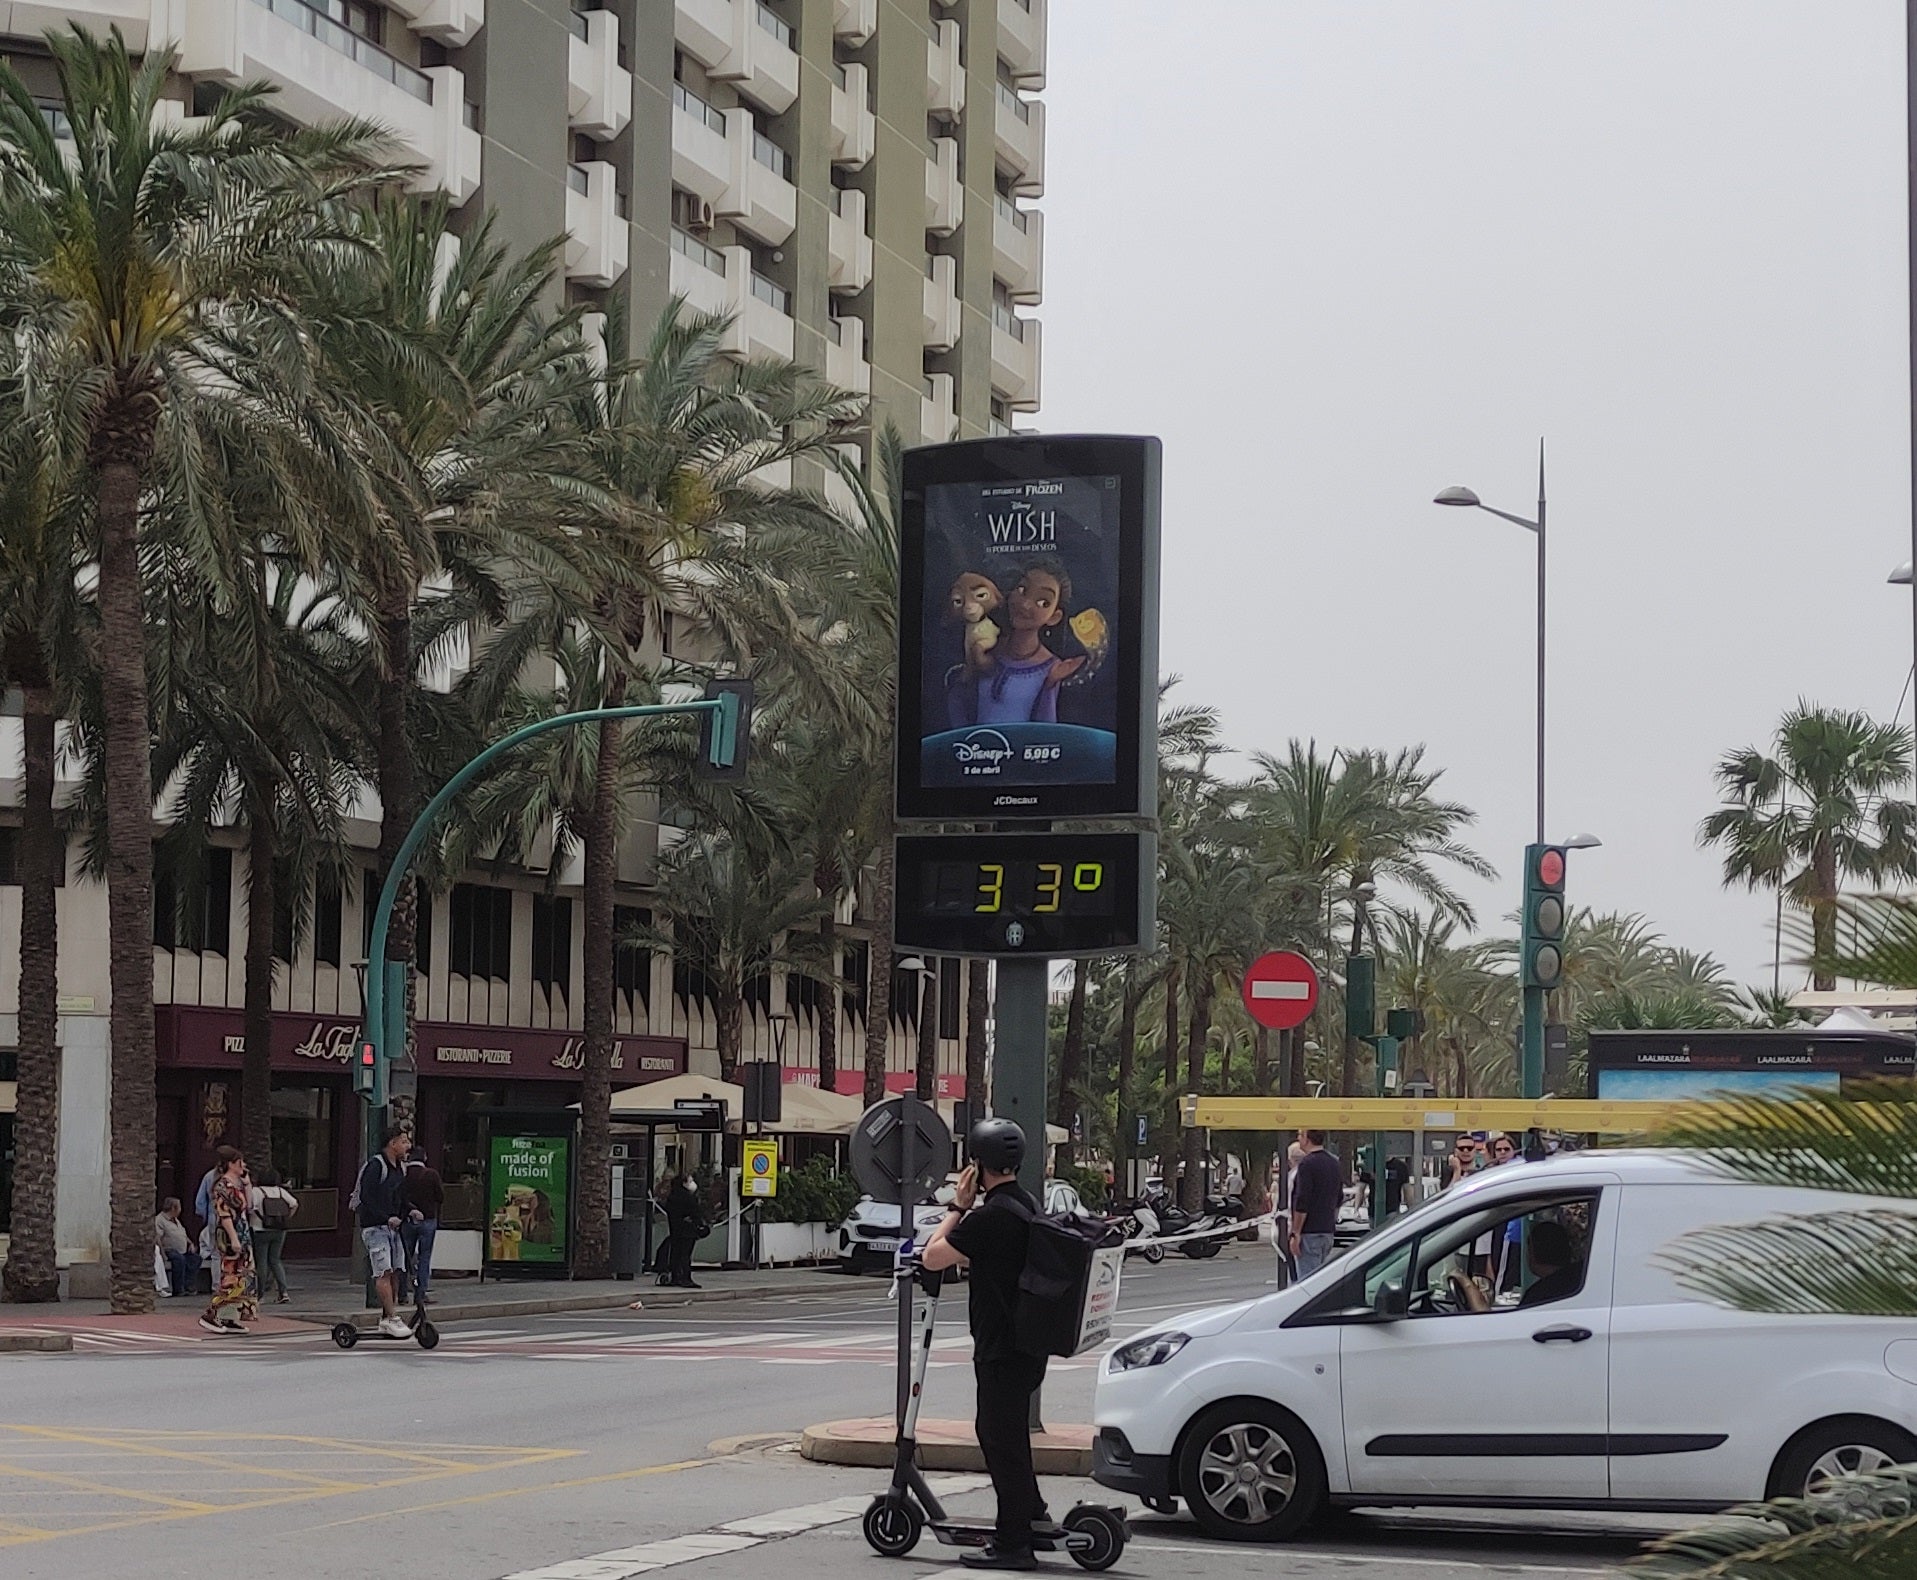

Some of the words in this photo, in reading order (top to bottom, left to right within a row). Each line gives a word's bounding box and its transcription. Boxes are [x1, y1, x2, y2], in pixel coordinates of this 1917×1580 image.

[1025, 482, 1063, 497] FROZEN
[988, 510, 1055, 543] WISH
[971, 766, 981, 775] de
[982, 766, 1001, 775] abril
[994, 796, 1039, 806] JCDecaux
[224, 1036, 246, 1053] PIZZ
[500, 1151, 537, 1165] made
[539, 1151, 555, 1165] of
[508, 1164, 549, 1178] fusion
